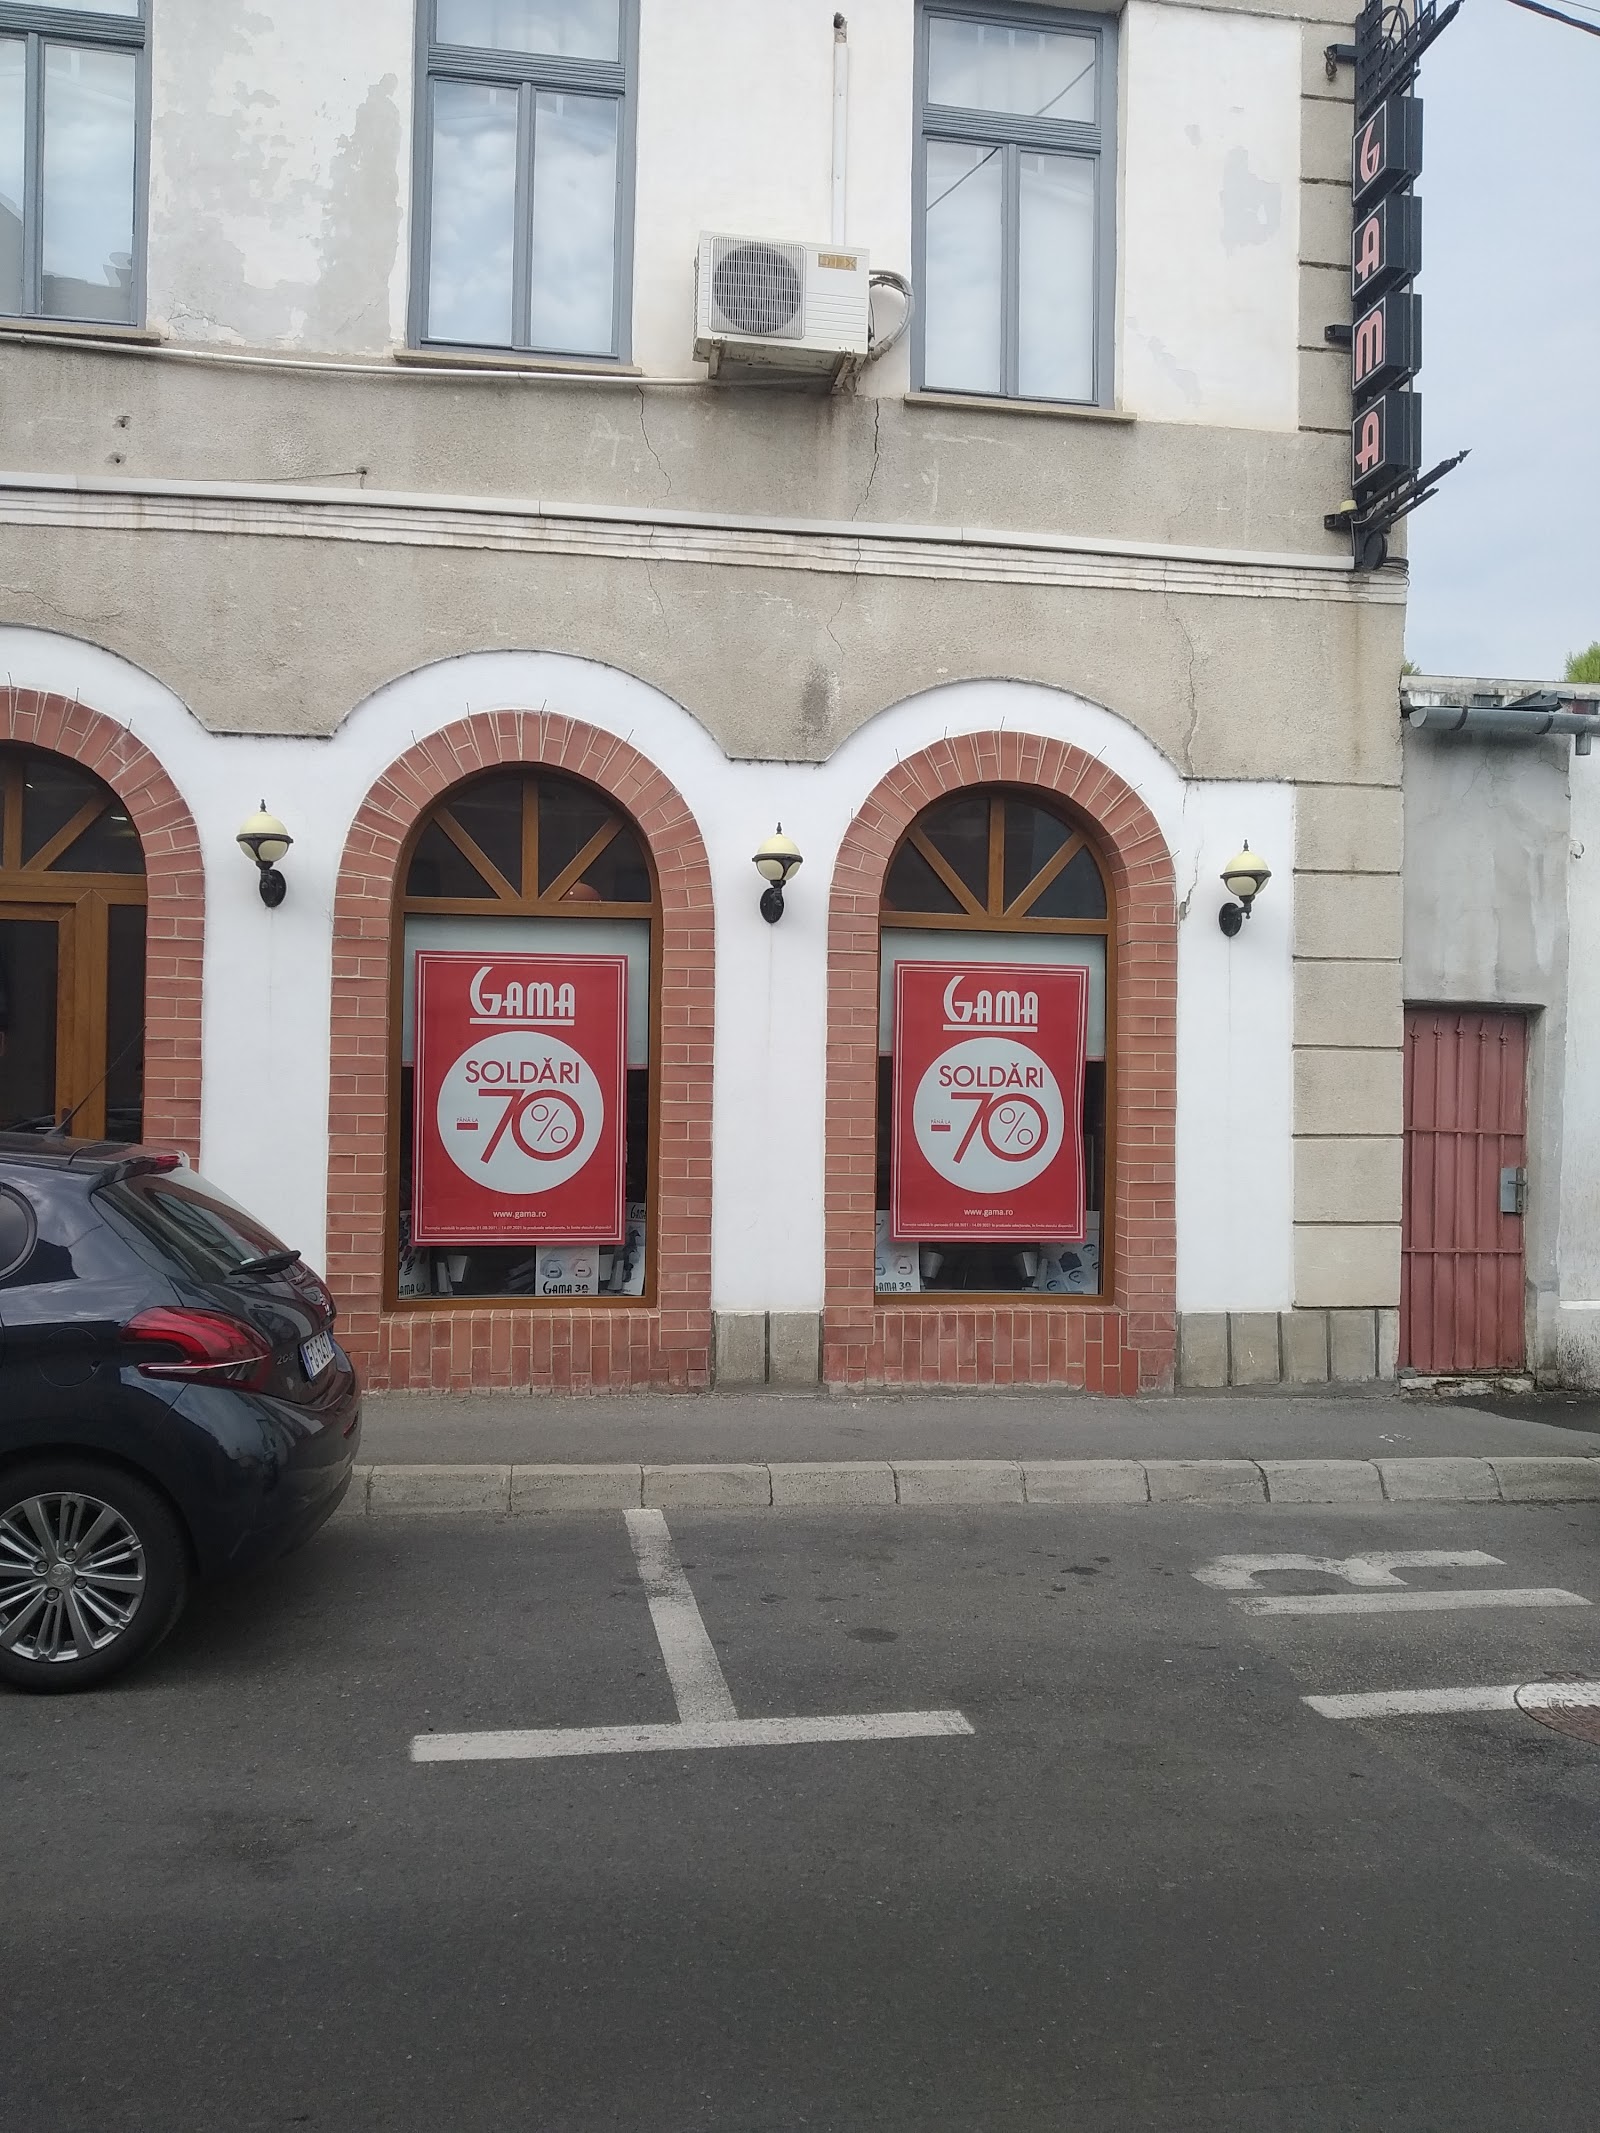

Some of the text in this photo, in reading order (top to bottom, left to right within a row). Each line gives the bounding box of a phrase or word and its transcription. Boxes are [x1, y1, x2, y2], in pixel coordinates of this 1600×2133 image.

[464, 1057, 580, 1084] SOLDĂRI
[938, 1062, 1044, 1089] SOLDĂRI
[492, 1211, 547, 1220] www.gama.ro
[963, 1209, 1014, 1217] www.gama.ro
[400, 1283, 415, 1296] AMA
